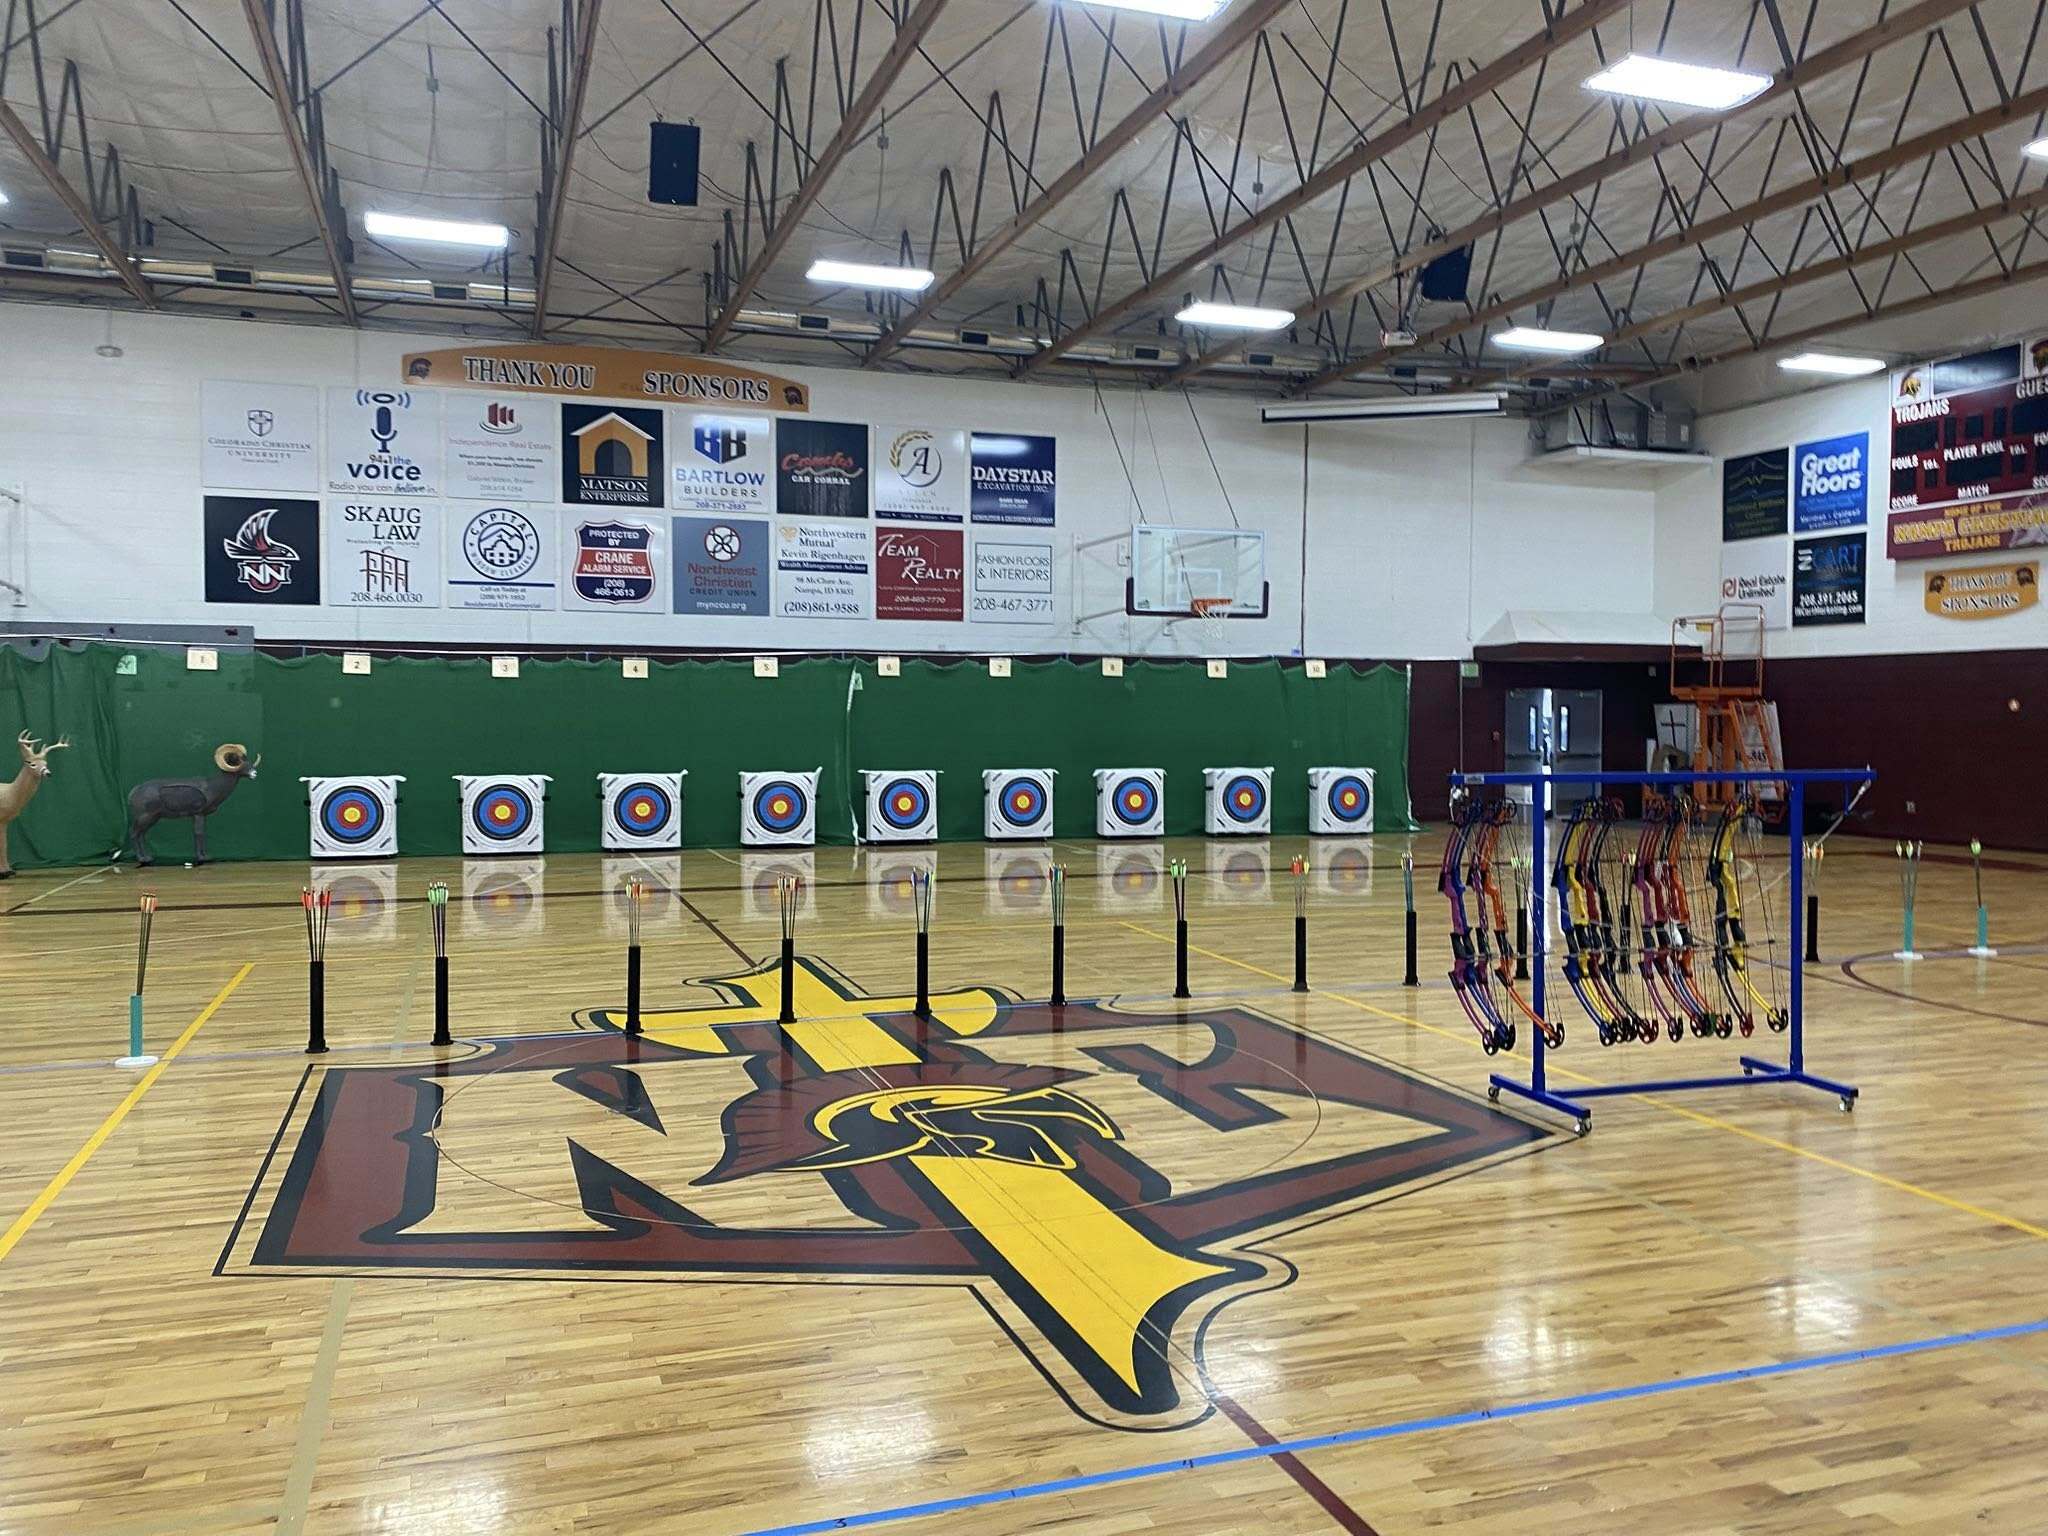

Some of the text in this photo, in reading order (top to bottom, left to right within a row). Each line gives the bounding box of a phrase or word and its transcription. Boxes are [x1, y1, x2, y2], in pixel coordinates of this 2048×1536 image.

[463, 356, 771, 403] THANK YOU SPONSORS
[1893, 399, 1950, 424] TROJANS
[262, 440, 311, 449] CHRISTIAN
[509, 440, 527, 449] Real
[1943, 439, 2004, 462] PLAYER FOUL
[227, 450, 291, 459] UNIVERSITY
[1801, 446, 1861, 476] Great
[1891, 454, 1919, 471] FOULS
[346, 463, 421, 481] voice
[675, 468, 765, 486] BARTLOW
[791, 474, 811, 483] CAR
[972, 466, 1054, 485] DAYSTAR
[580, 478, 648, 491] MATSON
[684, 485, 758, 497] BUILDERS
[977, 482, 1031, 492] EXCAVATION
[1801, 470, 1861, 497] Floors
[1957, 483, 1990, 499] MATCH
[580, 490, 649, 502] ENTERPRISES
[344, 505, 422, 524] SKAUG
[373, 524, 421, 541] LAW
[470, 512, 533, 540] CAPITAL
[800, 527, 867, 540] Northwestern
[588, 529, 640, 540] PROTECTED
[608, 538, 620, 547] BY
[800, 538, 835, 548] Mutual
[878, 534, 919, 557] TEAM
[1944, 533, 2001, 552] TROJANS
[595, 551, 634, 564] CRANE
[781, 549, 809, 558] Kevin
[582, 563, 647, 575] ALARM SERVICE
[687, 562, 758, 577] Northwest
[902, 558, 962, 585] REALTY
[989, 568, 1049, 581] INTERIORS
[693, 574, 753, 589] Christian
[1949, 577, 1985, 592] THANK
[689, 587, 723, 596] CREDIT
[974, 597, 1053, 612] 208-467-3771
[1940, 593, 2020, 613] SPONSORS
[353, 660, 361, 669] 2
[503, 664, 509, 672] 3
